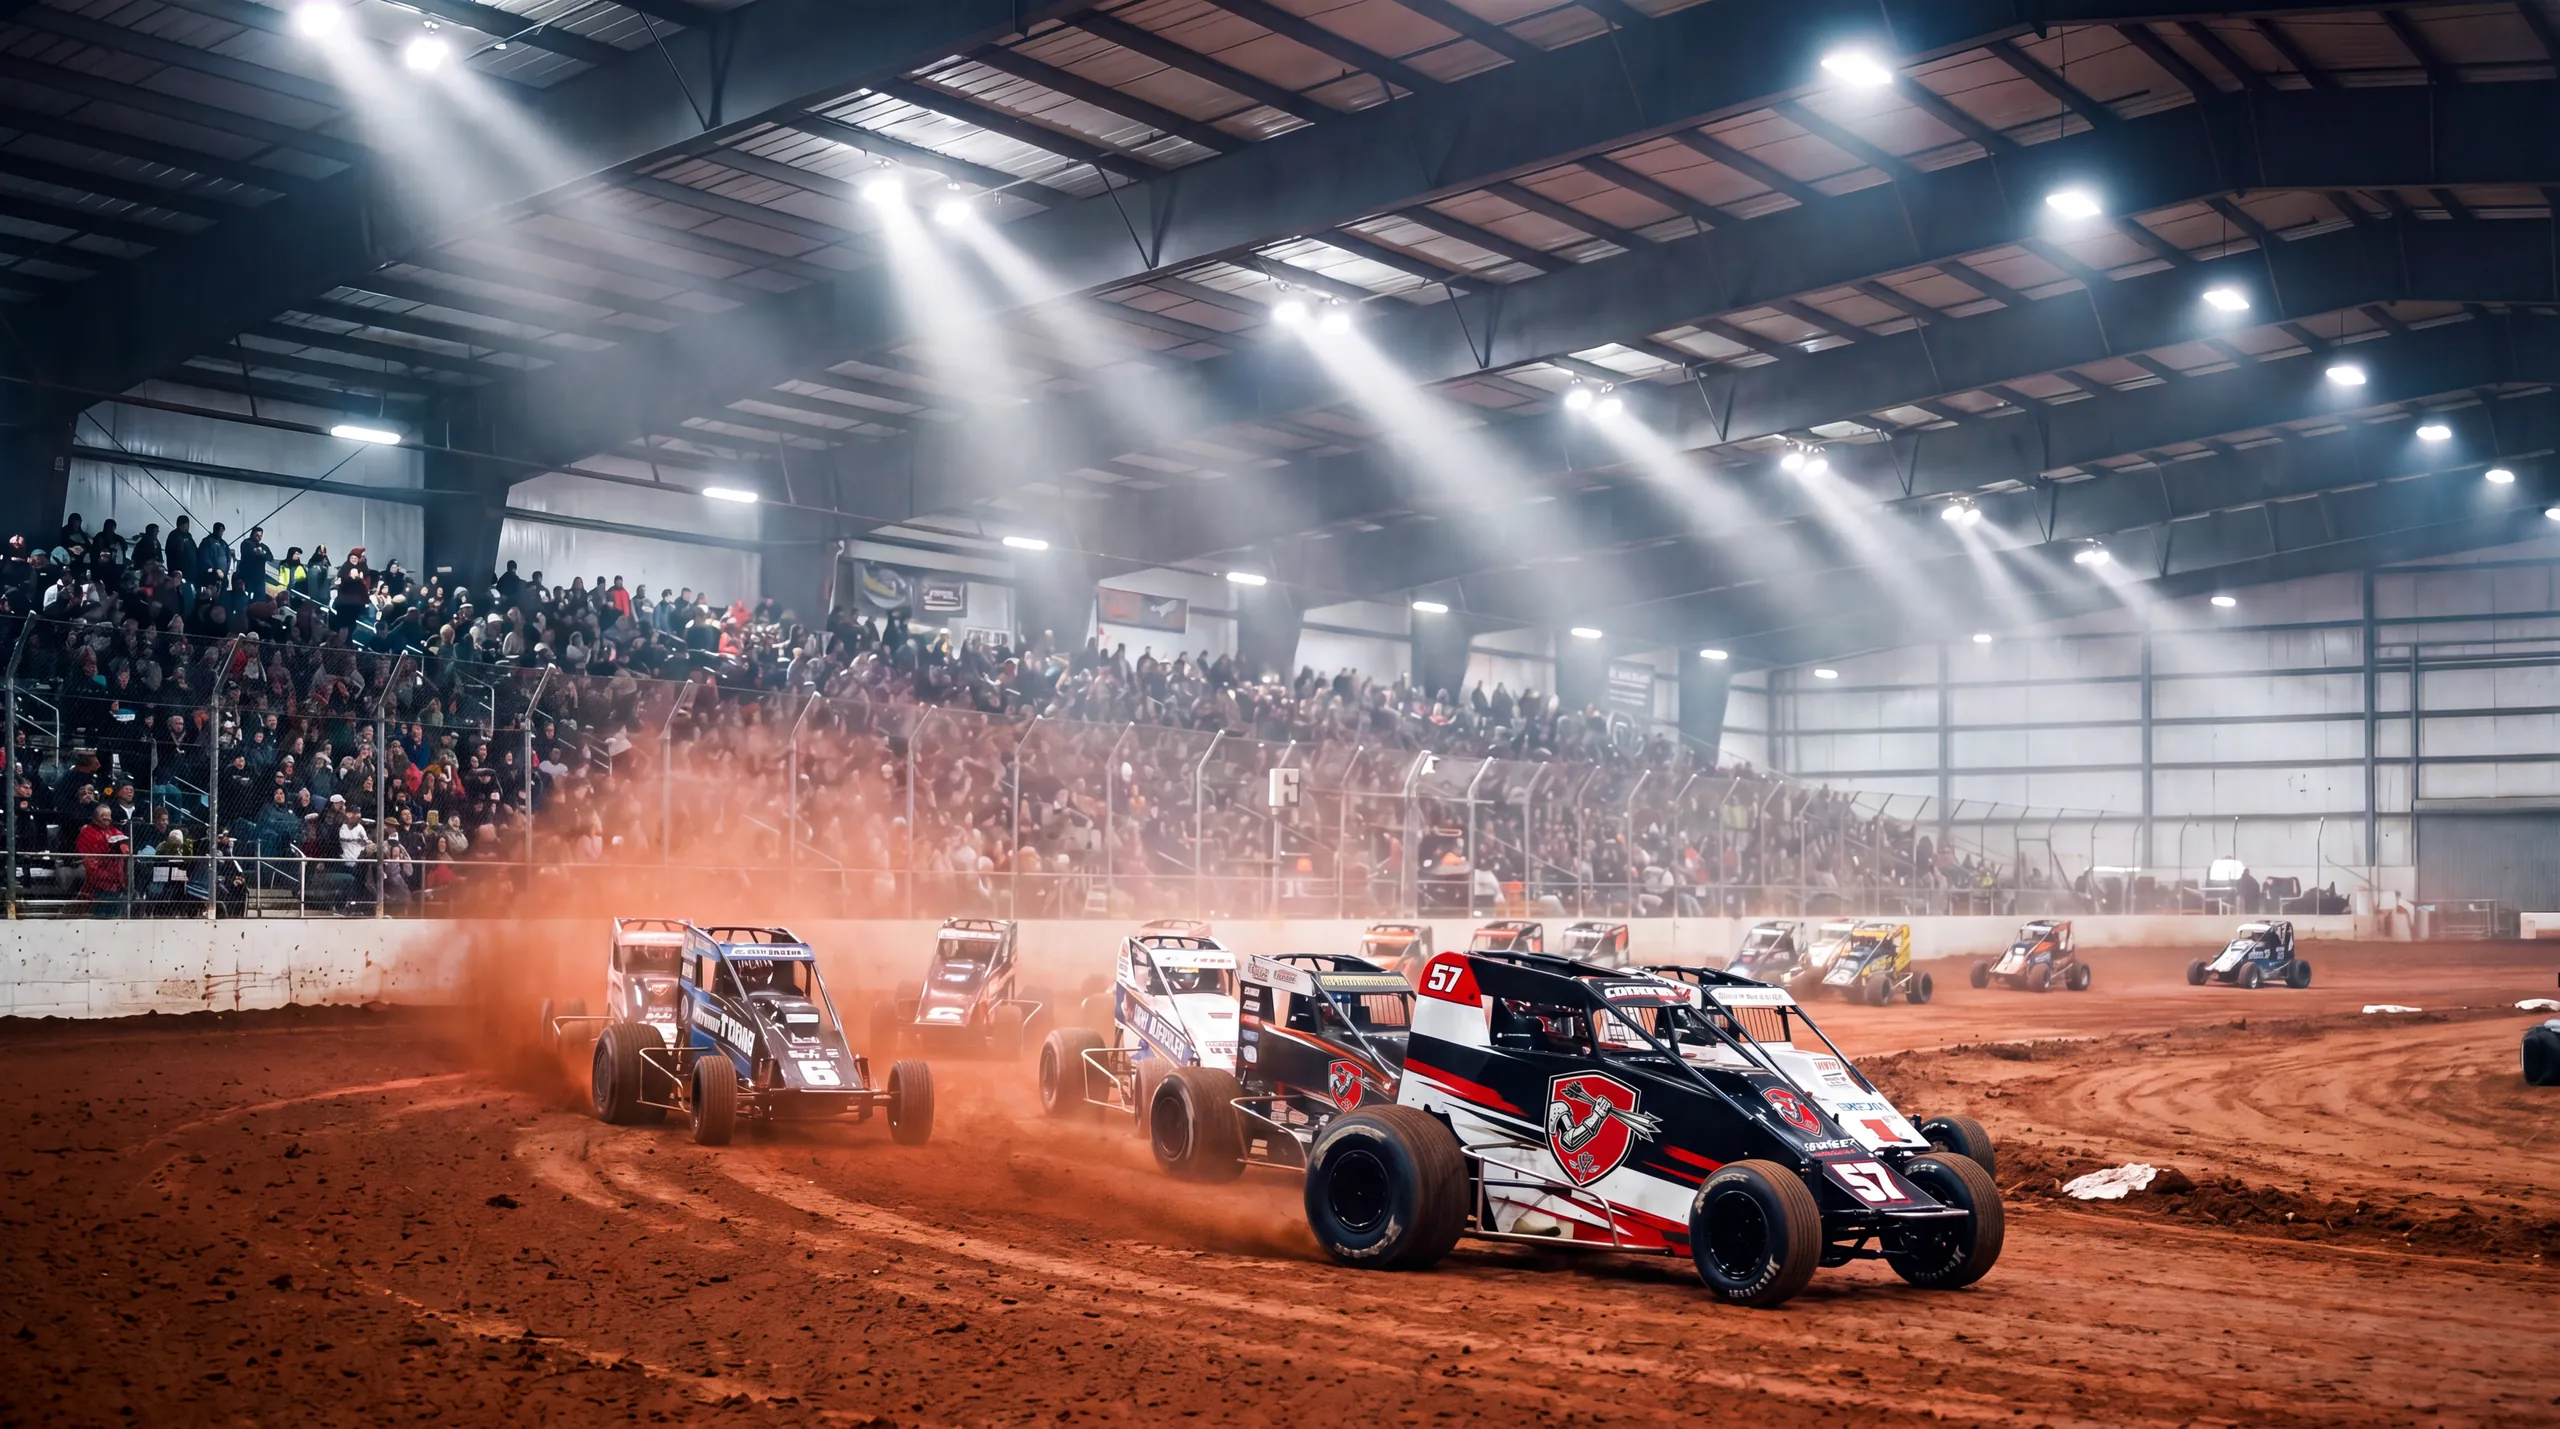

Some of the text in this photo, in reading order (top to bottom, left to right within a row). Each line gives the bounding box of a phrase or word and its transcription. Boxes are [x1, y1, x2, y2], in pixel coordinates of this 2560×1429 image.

[1427, 963, 1463, 993] 57
[797, 1060, 841, 1086] 6
[1860, 1119, 1902, 1142] 1
[1830, 1161, 1907, 1203] 57
